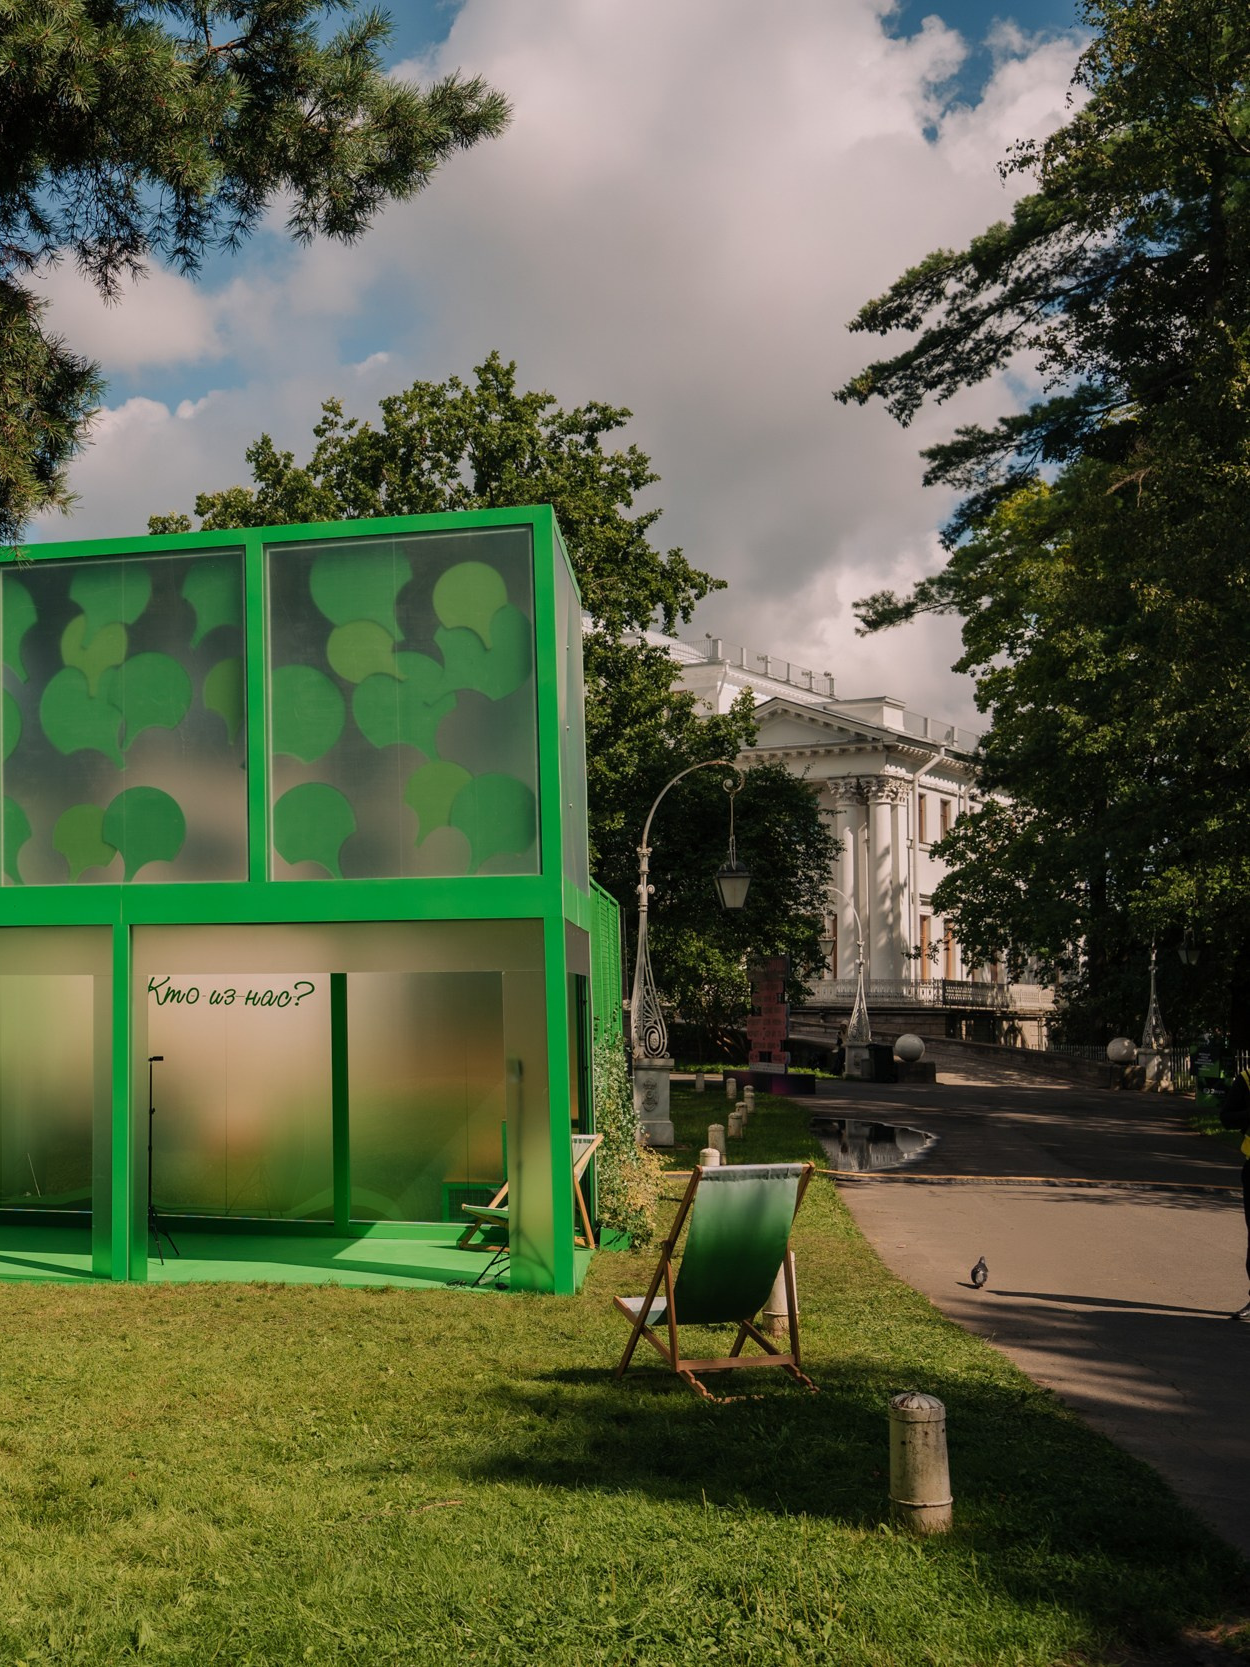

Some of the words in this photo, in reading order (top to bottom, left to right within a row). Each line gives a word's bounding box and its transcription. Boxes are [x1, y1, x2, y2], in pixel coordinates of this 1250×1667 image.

[148, 976, 200, 1006] Кто
[209, 988, 237, 1006] из
[244, 981, 316, 1008] нас?
